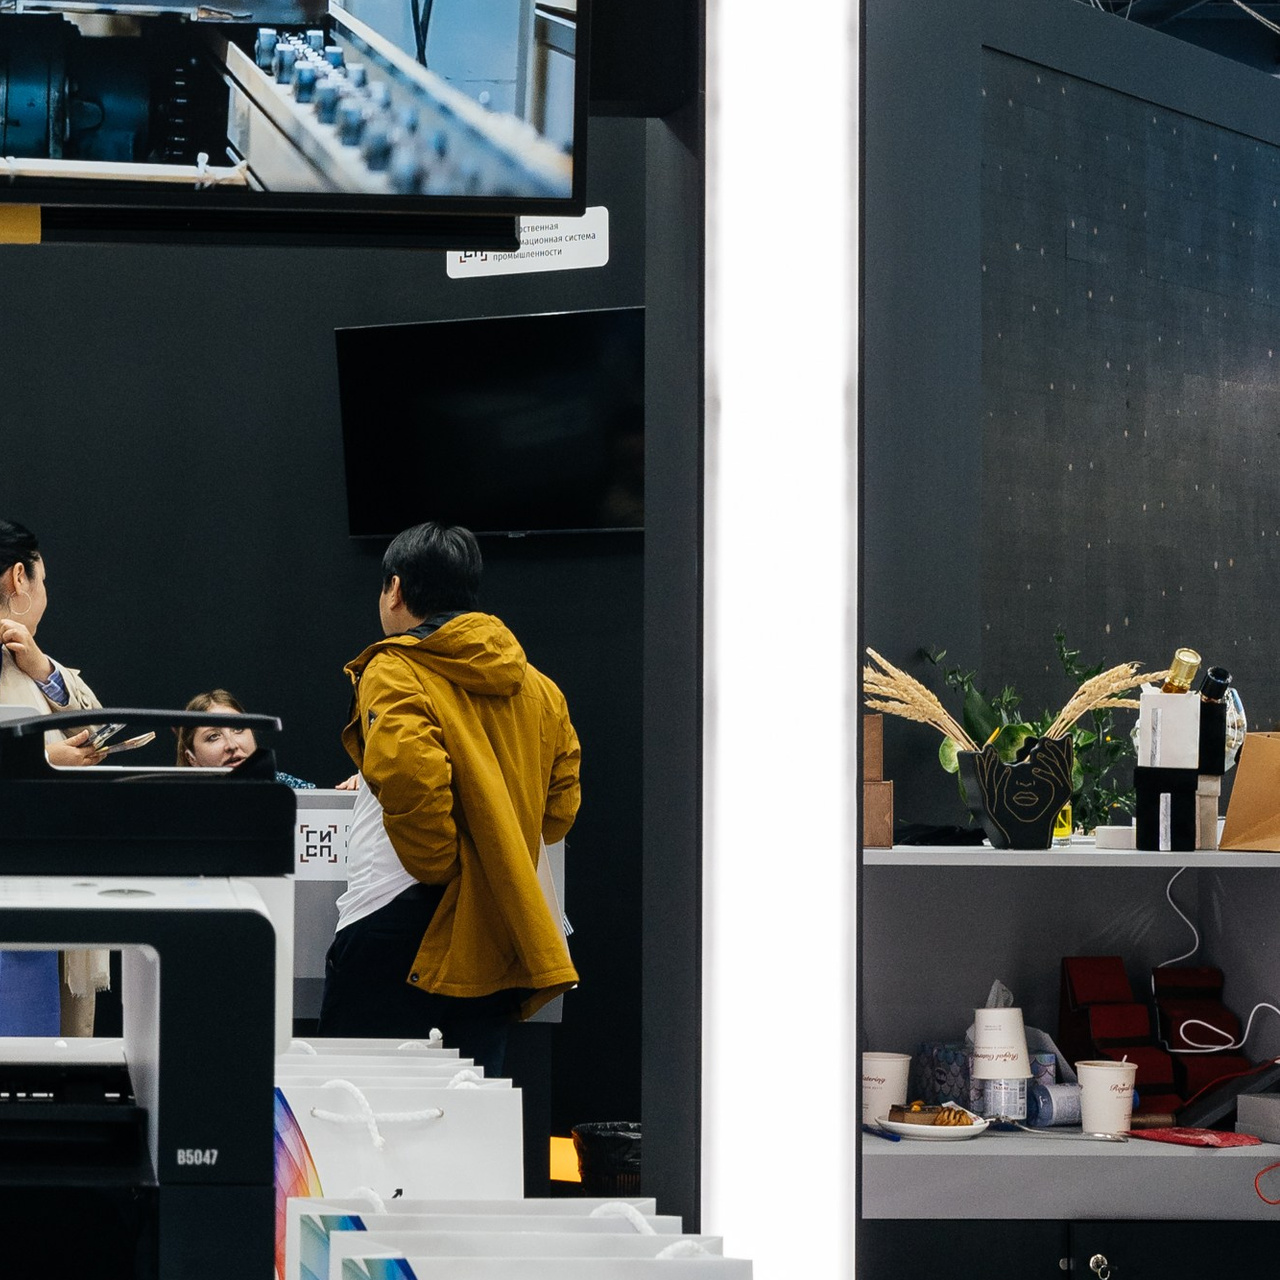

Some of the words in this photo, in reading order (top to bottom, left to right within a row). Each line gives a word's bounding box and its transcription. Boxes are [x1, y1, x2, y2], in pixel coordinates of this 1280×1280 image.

[564, 232, 596, 242] система
[492, 248, 563, 262] промышленности
[306, 830, 332, 843] ГИ
[306, 844, 332, 858] СП
[862, 1075, 886, 1084] atering
[176, 1148, 219, 1167] B5047
